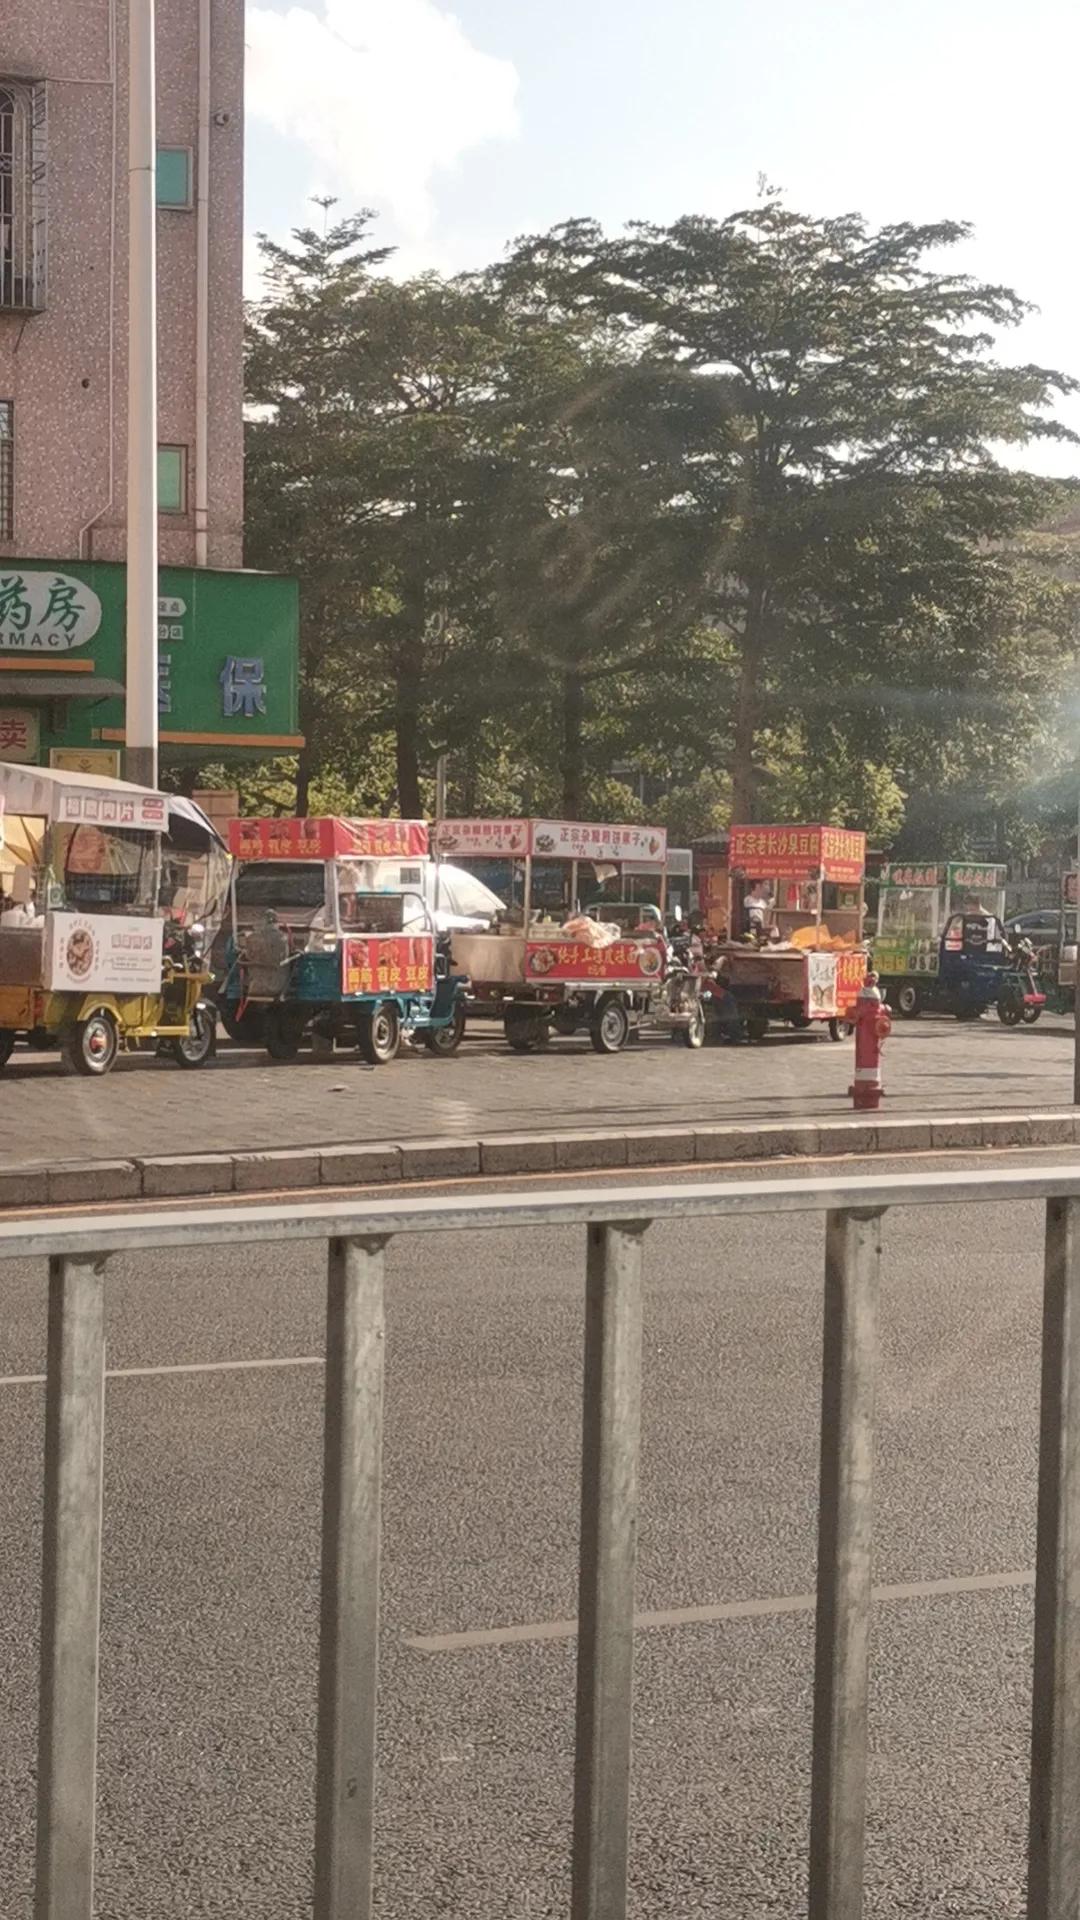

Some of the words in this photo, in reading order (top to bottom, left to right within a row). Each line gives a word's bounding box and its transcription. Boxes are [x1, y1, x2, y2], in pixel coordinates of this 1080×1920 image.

[0, 575, 86, 632] 药房
[0, 632, 75, 647] MACY
[0, 718, 27, 749] 卖
[735, 832, 820, 856] 正宗老长沙臭豆腐
